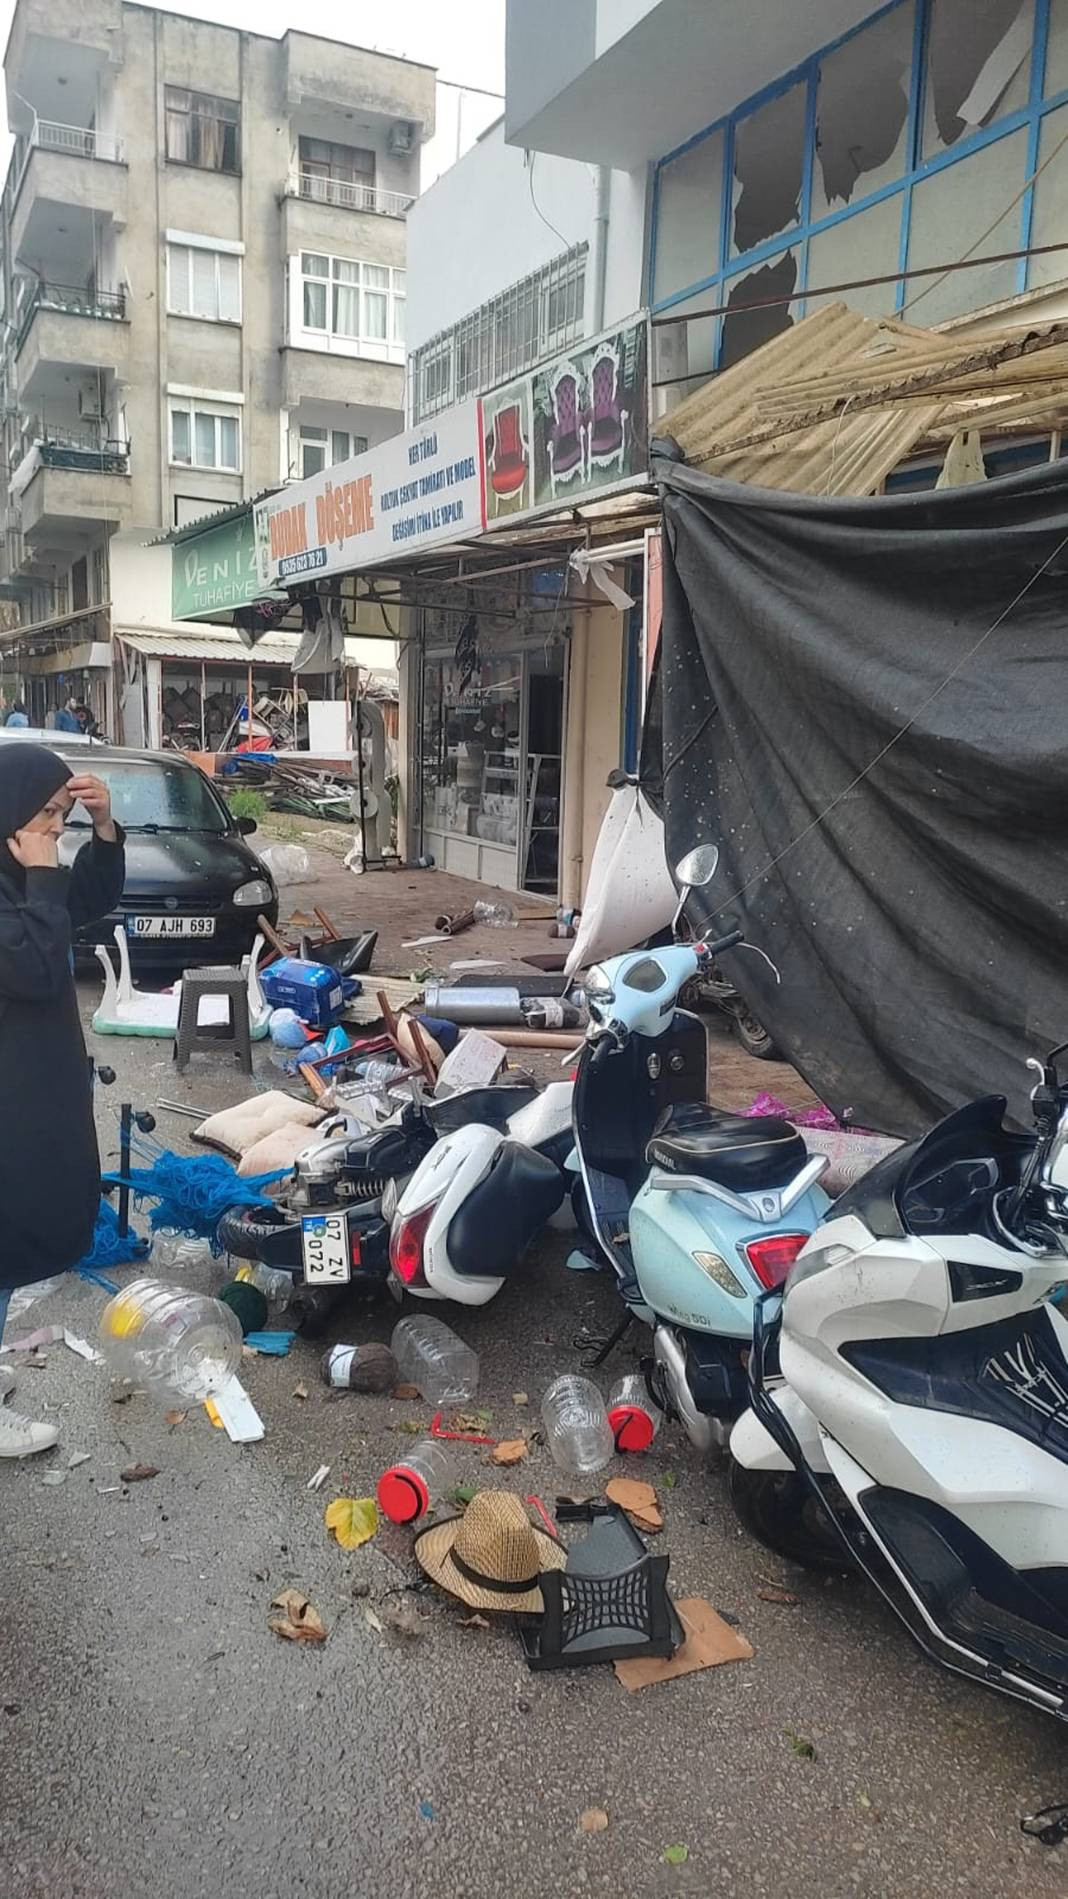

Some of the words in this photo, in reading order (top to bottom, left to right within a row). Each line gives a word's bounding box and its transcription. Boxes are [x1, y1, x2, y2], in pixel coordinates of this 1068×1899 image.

[446, 466, 454, 486] VE
[454, 456, 476, 483] MODEL
[315, 474, 374, 551] DÖŞEME
[316, 549, 324, 565] 21
[193, 580, 257, 609] TUHAFİYE
[137, 919, 152, 932] 07
[160, 919, 183, 932] AJH
[190, 919, 212, 932] 693
[326, 1220, 341, 1241] 07
[308, 1240, 325, 1273] 072
[329, 1257, 344, 1278] ZV
